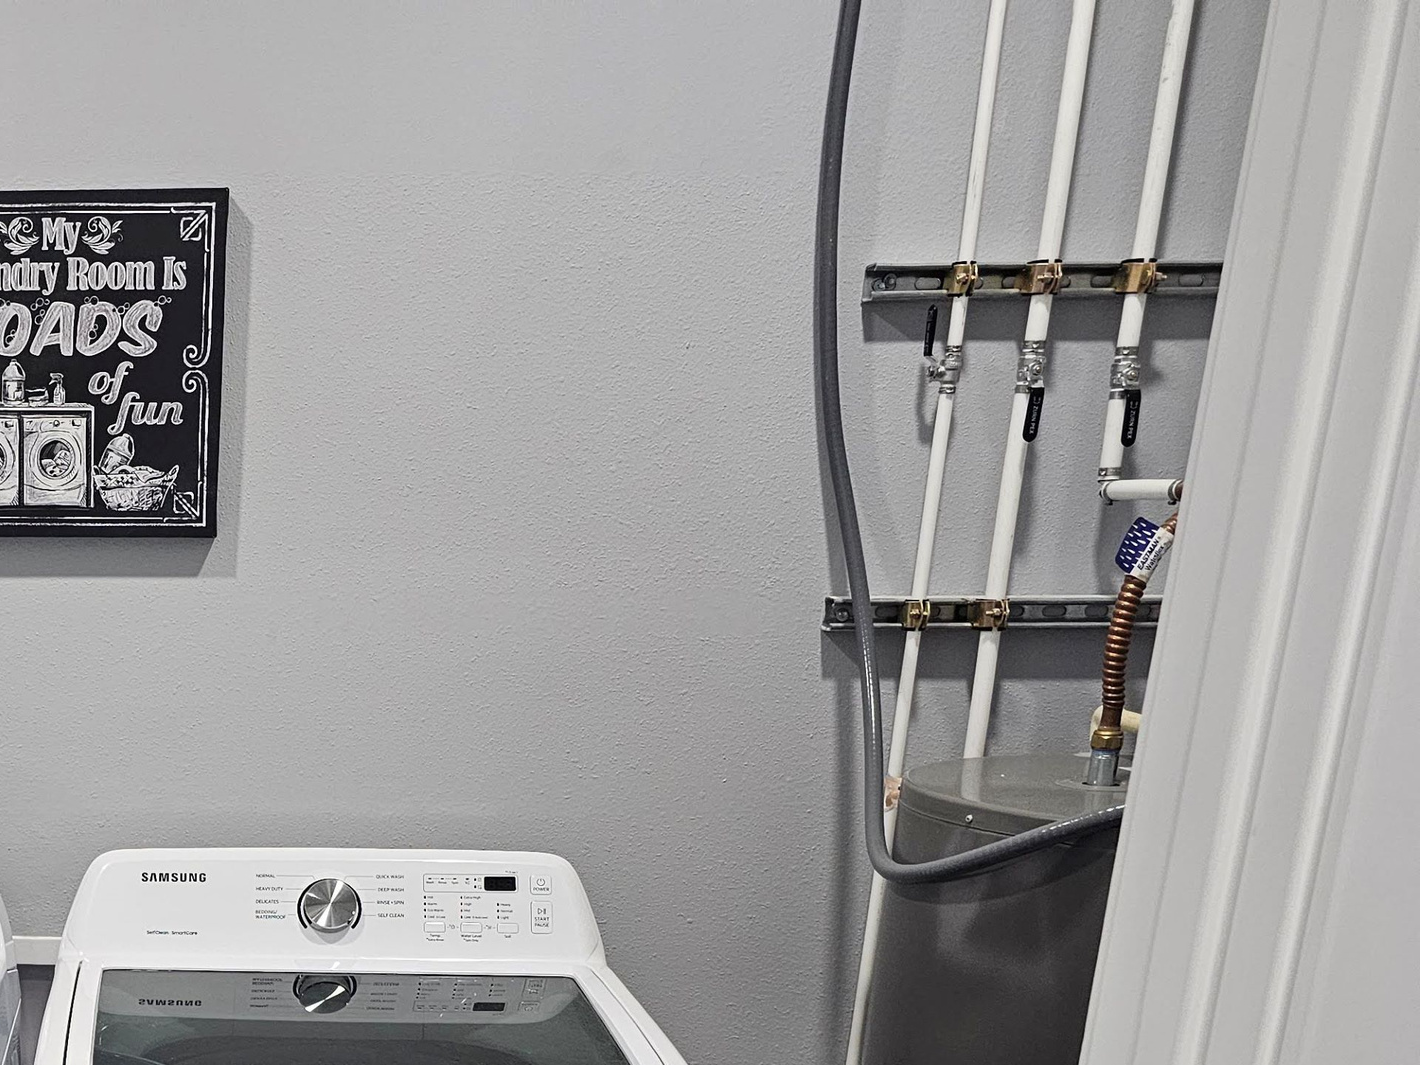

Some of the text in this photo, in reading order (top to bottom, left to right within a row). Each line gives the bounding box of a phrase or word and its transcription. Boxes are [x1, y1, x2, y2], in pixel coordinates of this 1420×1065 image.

[41, 217, 82, 255] My
[66, 257, 155, 291] Room
[162, 256, 188, 291] Is
[88, 361, 134, 405] of
[107, 391, 184, 435] fun
[1137, 538, 1160, 570] EASTMAN
[141, 872, 207, 883] SAMSUNG
